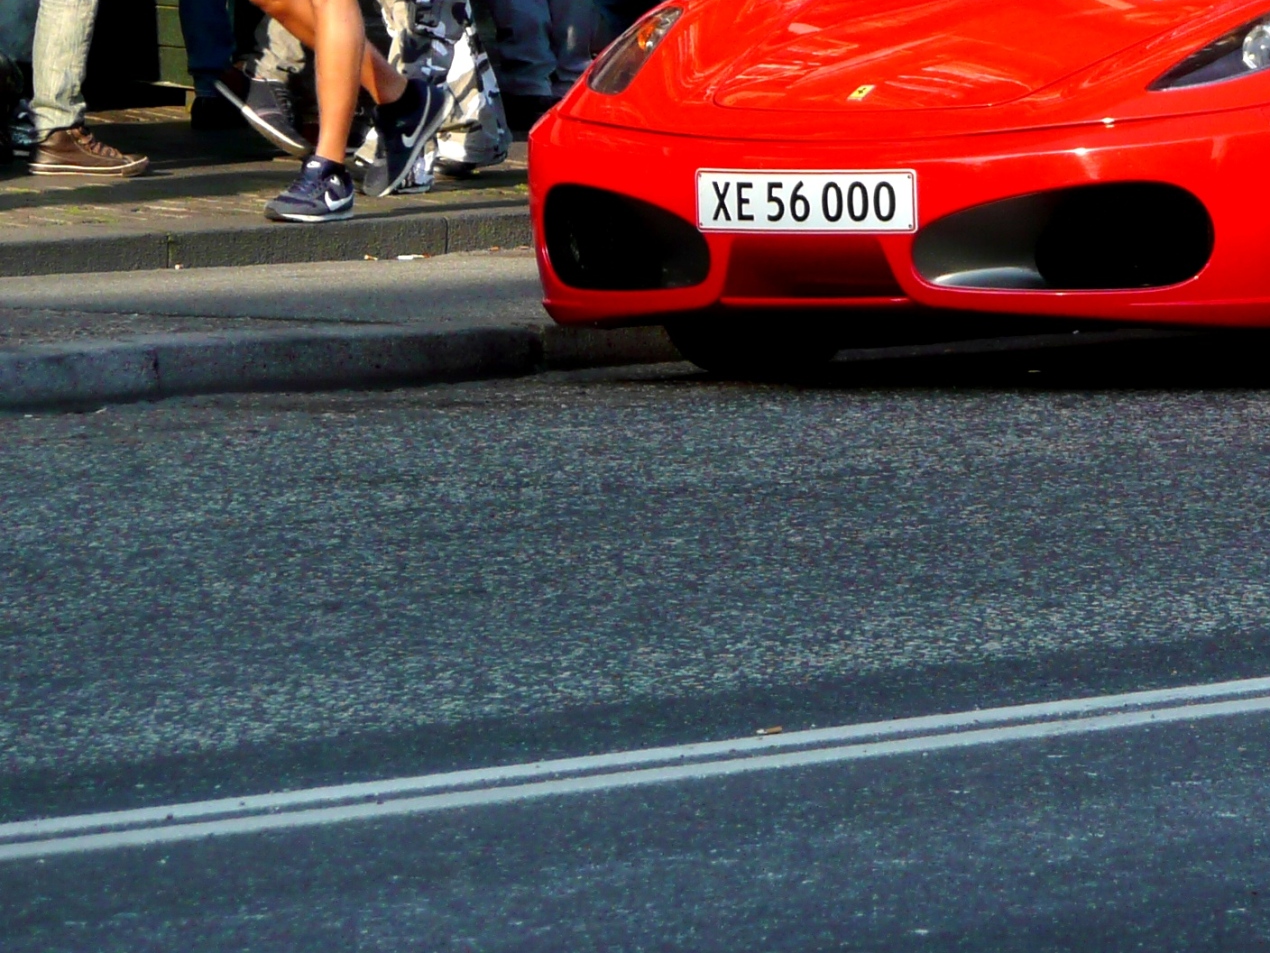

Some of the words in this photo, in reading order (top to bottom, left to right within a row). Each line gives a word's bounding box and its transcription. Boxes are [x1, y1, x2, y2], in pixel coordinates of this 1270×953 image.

[712, 181, 755, 222] XE
[766, 181, 811, 222] 56
[821, 181, 896, 223] 000
